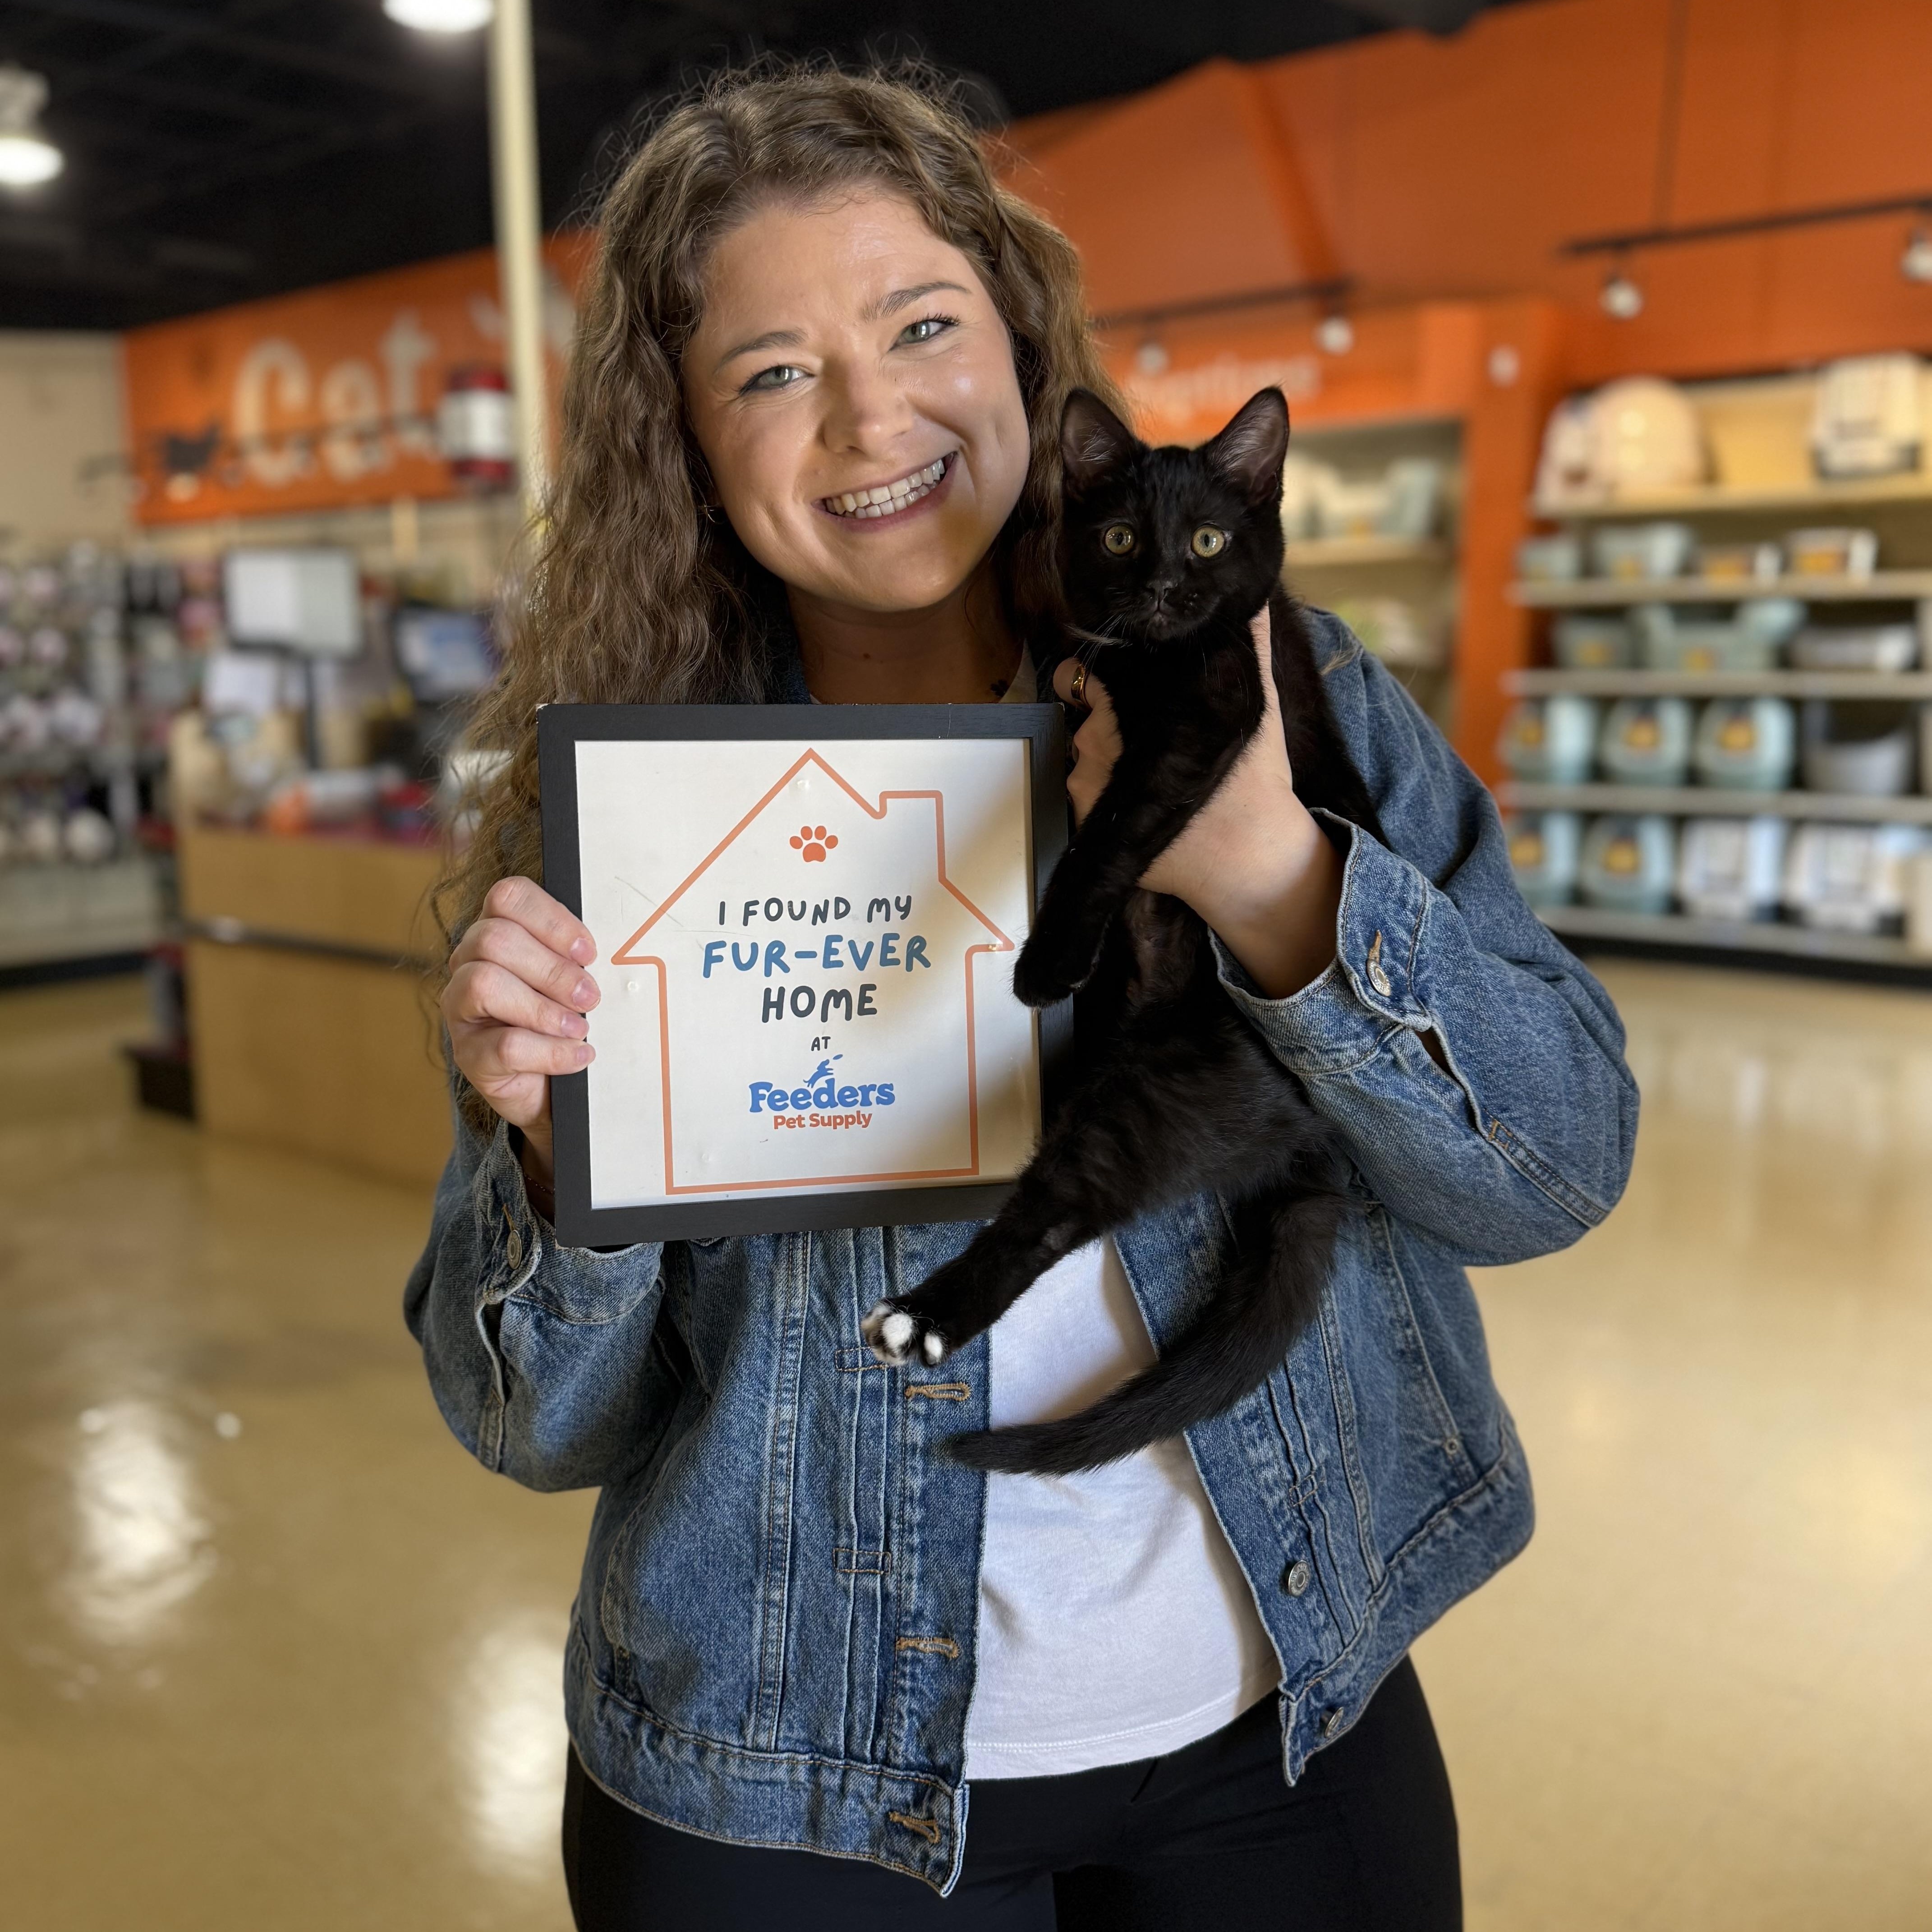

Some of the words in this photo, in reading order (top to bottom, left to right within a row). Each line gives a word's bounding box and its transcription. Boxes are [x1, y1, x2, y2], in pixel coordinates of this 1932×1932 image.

[719, 901, 726, 925] I
[743, 897, 851, 926] FOUND
[867, 895, 912, 923] MY
[703, 933, 931, 978] FUR-EVER
[762, 984, 878, 1023] HOME
[811, 1036, 831, 1052] AT
[749, 1078, 895, 1113] Feeders
[774, 1115, 805, 1129] Pet
[810, 1110, 872, 1130] Supply
